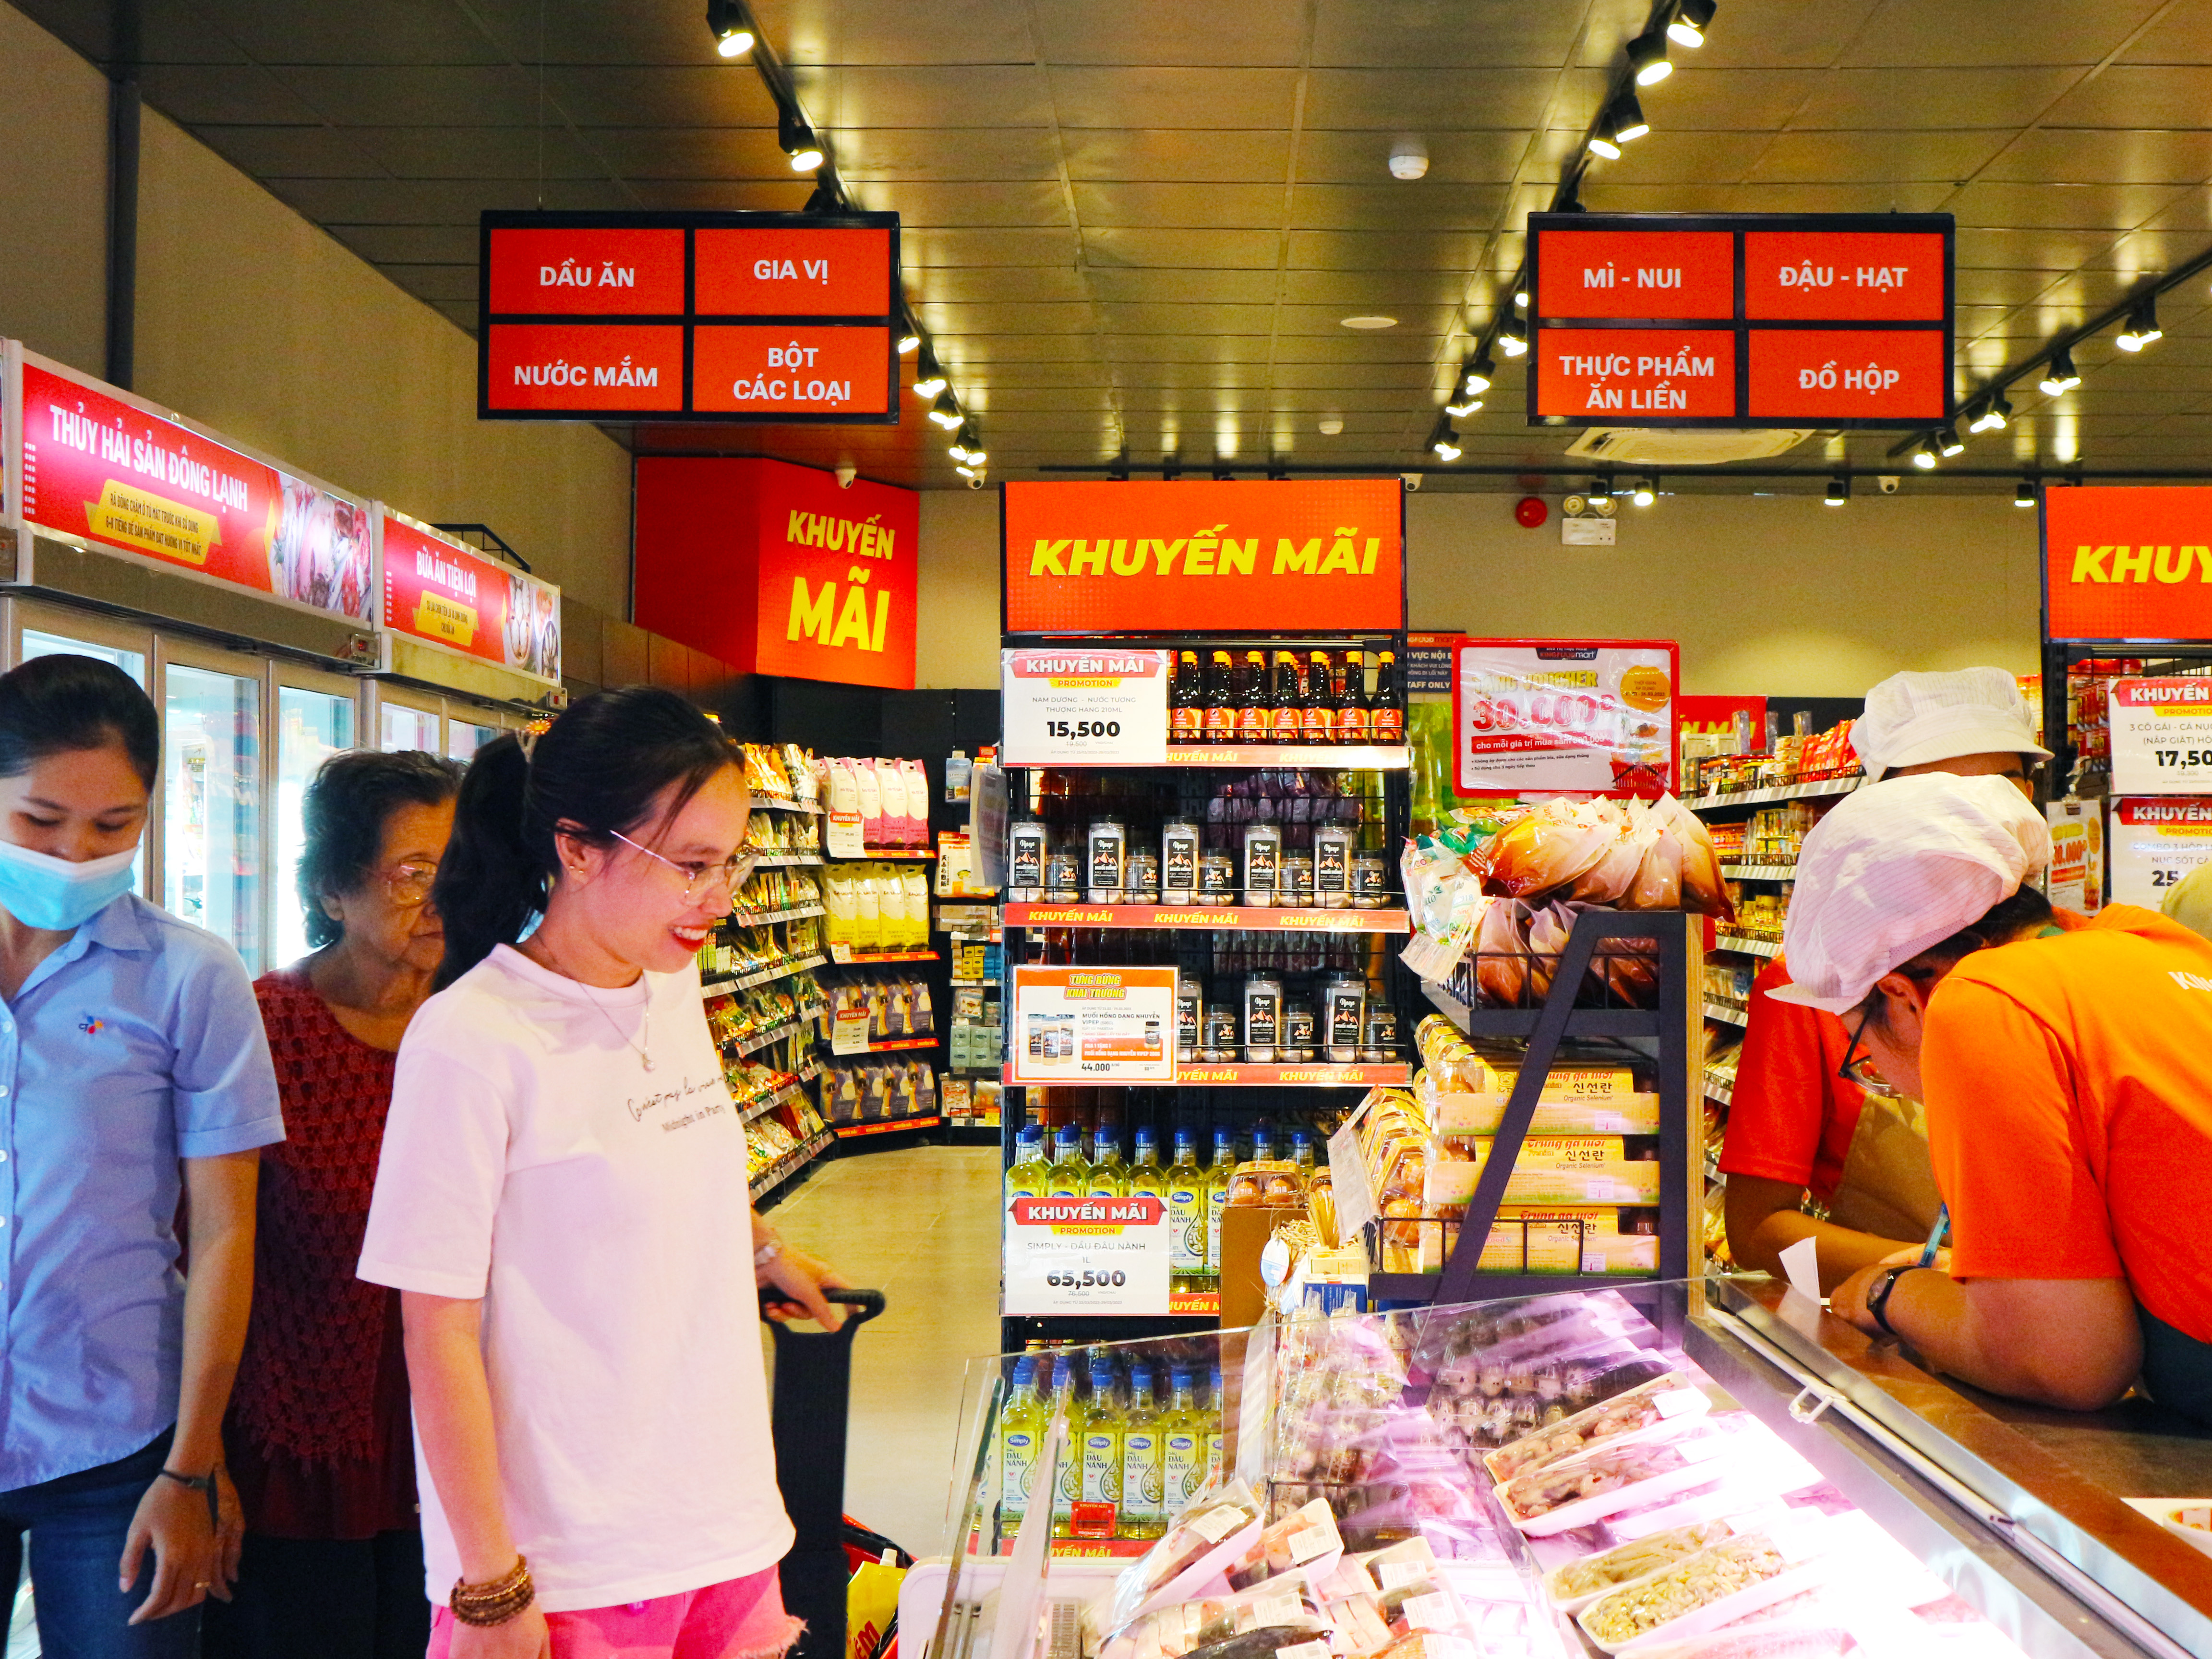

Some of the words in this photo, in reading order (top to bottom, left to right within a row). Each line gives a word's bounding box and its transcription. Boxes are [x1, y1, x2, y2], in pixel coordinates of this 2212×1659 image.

[541, 258, 591, 287] DẦU
[598, 262, 634, 287] ĂN
[754, 260, 797, 280] GIA
[802, 260, 828, 285] VỊ
[1584, 262, 1614, 288] MÌ
[1638, 268, 1681, 288] NUI
[1779, 260, 1834, 292] ĐẬU
[1857, 267, 1908, 292] HẠT
[769, 341, 818, 373] BỘT
[1559, 353, 1630, 381] THỰC
[1638, 346, 1714, 376] PHẨM
[515, 360, 587, 386] NƯỚC
[594, 355, 658, 386] MẮM
[1799, 361, 1837, 389] ĐỒ
[1845, 362, 1899, 395] HỘP
[733, 374, 786, 400] CÁC
[794, 381, 850, 406] LOẠI
[1586, 384, 1625, 409] ĂN
[1631, 380, 1686, 409] LIỀN
[50, 402, 98, 454] THỦY
[101, 417, 130, 468] HẢI
[134, 430, 166, 481] SẢN
[168, 445, 210, 497] ĐÔNG
[212, 470, 248, 513] LẠNH
[787, 509, 895, 560] KHUYẾN
[1029, 524, 1258, 576] KHUYẾN
[1272, 527, 1380, 575] MÃI
[417, 546, 432, 578] BỮA
[433, 551, 445, 585] ĂN
[447, 558, 463, 598] TIỆN
[464, 570, 476, 603] LỢI
[787, 565, 890, 652] MÃI
[1026, 656, 1103, 673] KHUYẾN
[1109, 656, 1144, 673] MÃI
[1411, 652, 1429, 661] VỰC
[1431, 650, 1445, 661] NỘI
[2131, 683, 2210, 701] KHUYẾN
[1047, 721, 1120, 740] 15,500
[2138, 722, 2151, 731] CÔ
[2155, 722, 2171, 731] GÁI
[2180, 722, 2192, 730] CÁ
[1493, 739, 1508, 748] mỗi
[1510, 740, 1522, 749] giá
[1524, 739, 1533, 748] trị
[1166, 750, 1208, 762] HUYẾN
[1212, 750, 1238, 762] MÃI
[2155, 750, 2212, 769] 17,50
[2176, 855, 2194, 864] SỐT
[1029, 908, 1084, 922] KHUYẾN
[1086, 910, 1113, 922] MÃI
[1154, 911, 1210, 924] KHUYẾN
[1212, 913, 1238, 924] MÃI
[1280, 914, 1336, 926] KHUYẾN
[1336, 915, 1364, 927] MÃI
[1066, 988, 1087, 998] KHAI
[1090, 987, 1125, 998] TRƯƠNG
[1176, 1068, 1208, 1081] UYẾN
[1212, 1069, 1238, 1081] MÃI
[1279, 1070, 1335, 1081] KHUYẾN
[1337, 1070, 1364, 1081] MÃI
[1573, 1083, 1612, 1093] 신선란
[1565, 1150, 1604, 1161] 신선란
[1028, 1201, 1106, 1220] KHUYẾN
[1111, 1202, 1147, 1220] MÃI
[1027, 1242, 1062, 1250] SIMPLY
[1070, 1240, 1091, 1250] DẦU
[1094, 1242, 1116, 1251] ĐẬU
[1118, 1241, 1146, 1250] NÀNH
[1047, 1270, 1126, 1289] 65,500
[1051, 1545, 1082, 1557] UYẾN
[1084, 1546, 1111, 1557] MÃI
